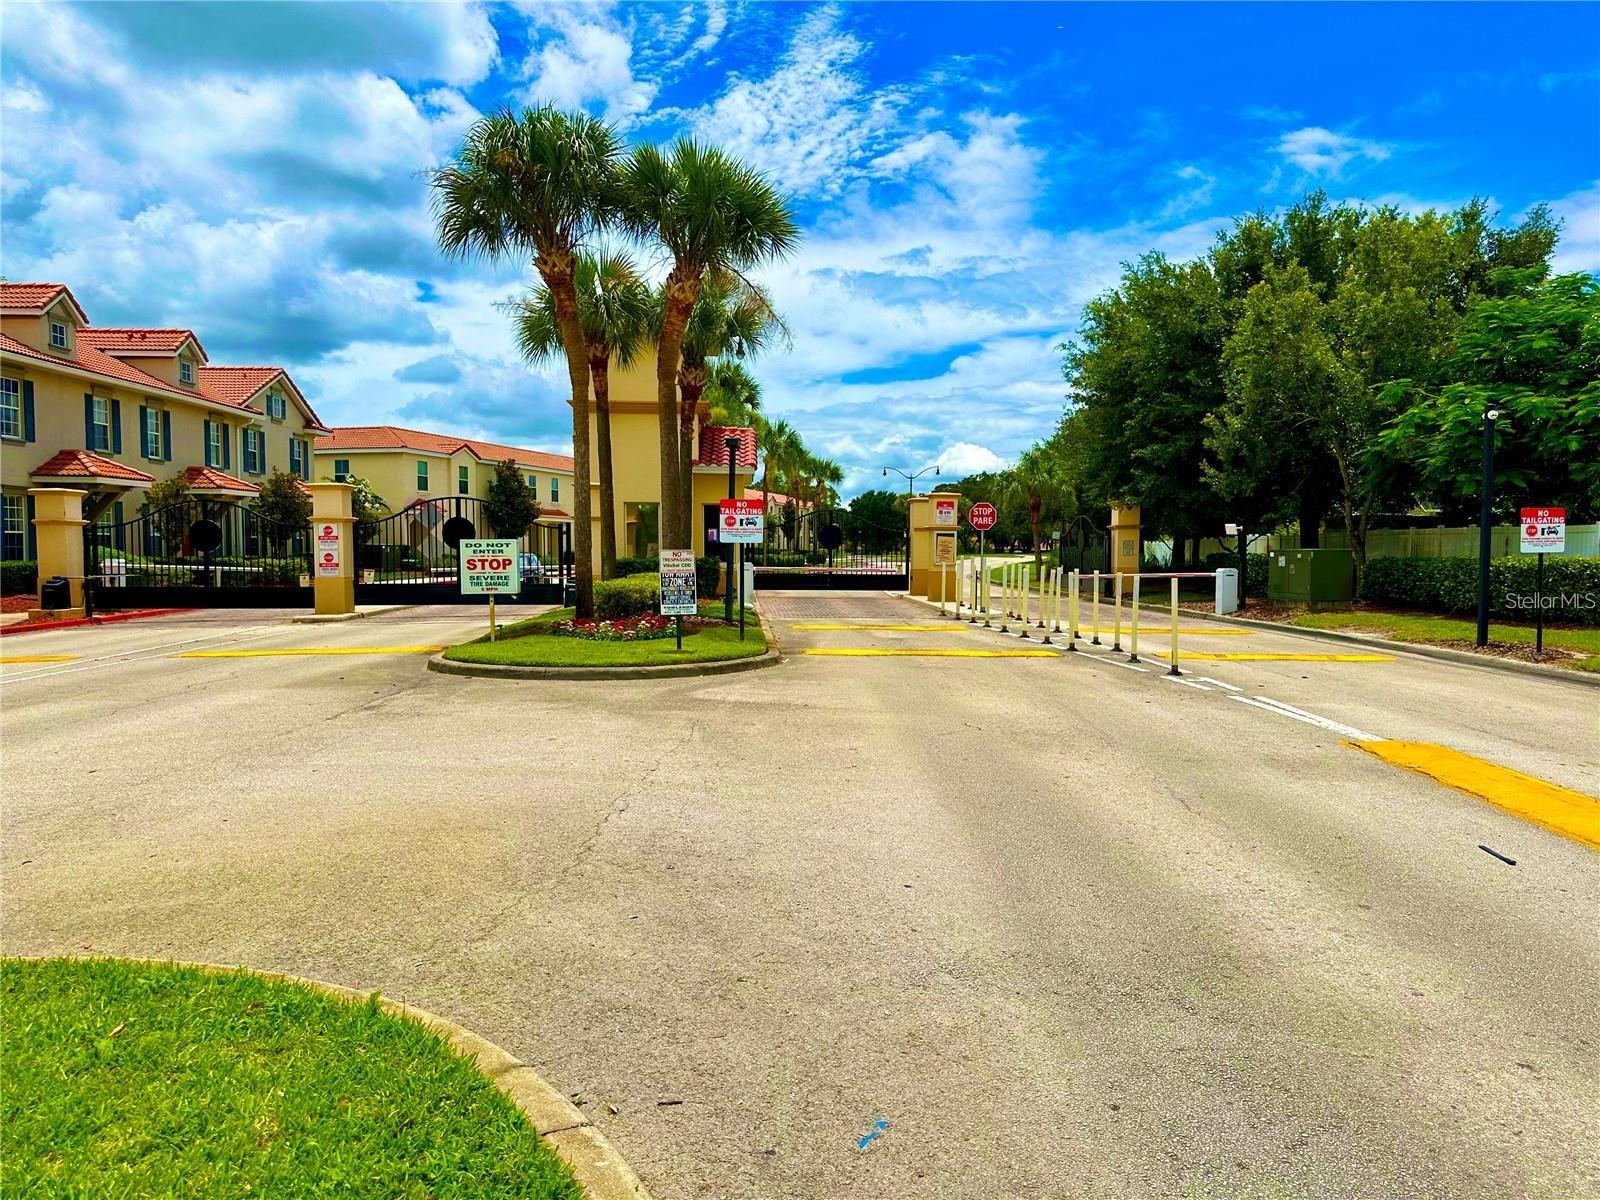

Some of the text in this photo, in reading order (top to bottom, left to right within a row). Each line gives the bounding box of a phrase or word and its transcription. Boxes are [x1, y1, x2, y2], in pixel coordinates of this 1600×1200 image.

[720, 507, 763, 515] TAILGATING
[973, 507, 993, 516] STOP
[973, 517, 993, 525] PARE
[1521, 516, 1565, 524] TAILGATING
[466, 558, 513, 571] STOP
[669, 577, 686, 587] ZONE
